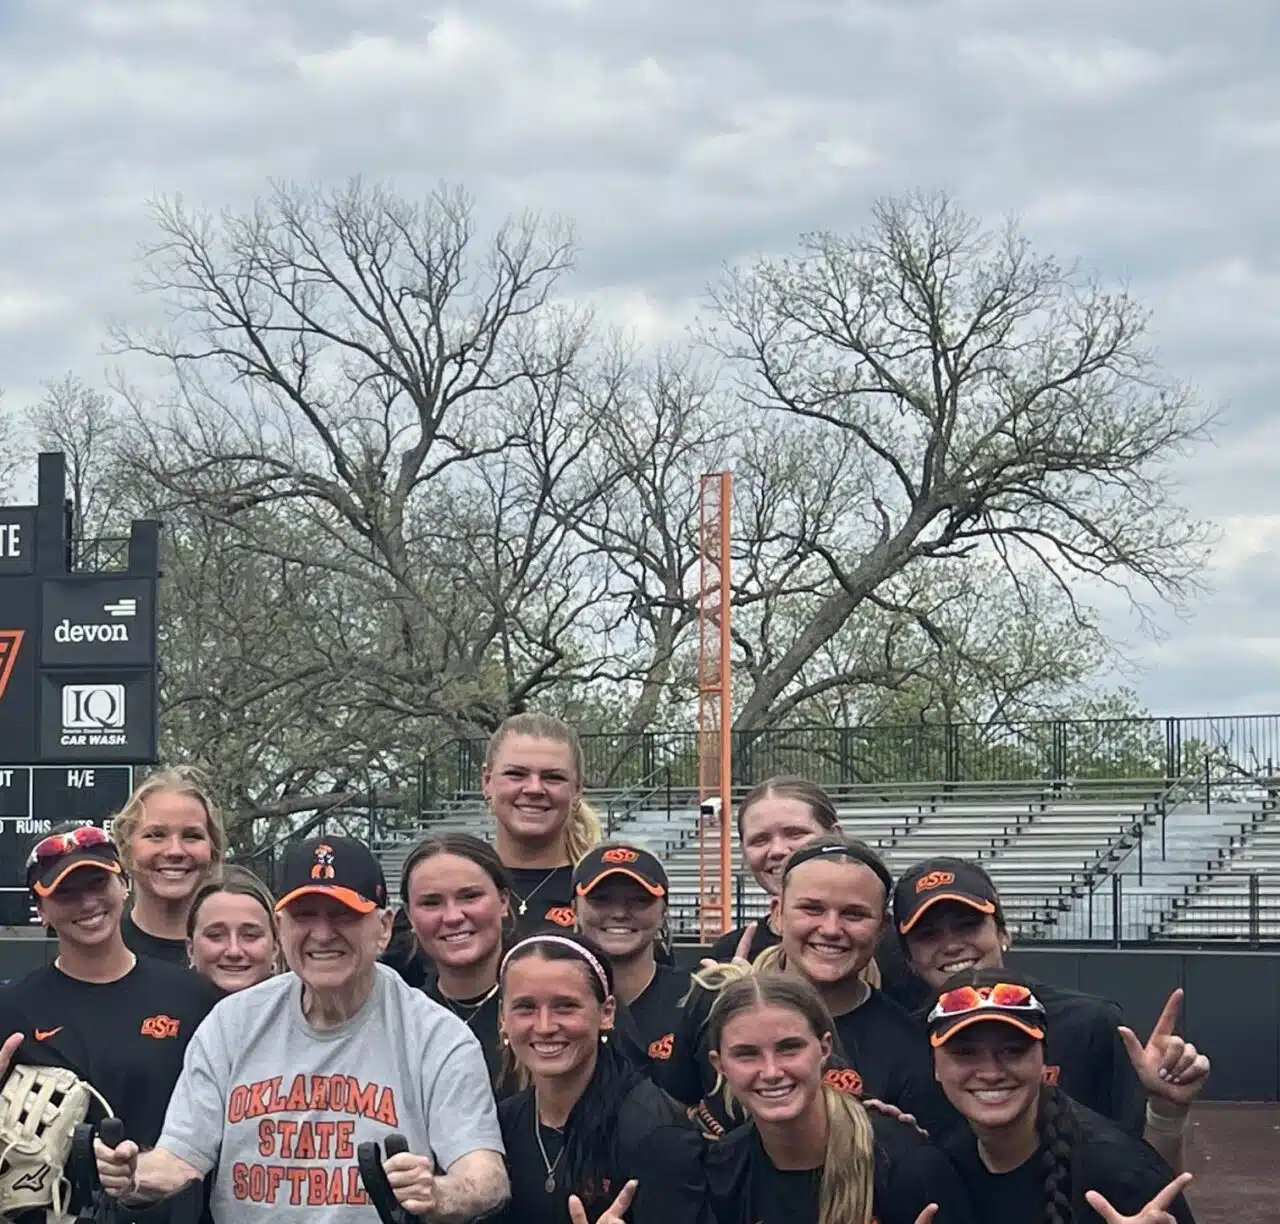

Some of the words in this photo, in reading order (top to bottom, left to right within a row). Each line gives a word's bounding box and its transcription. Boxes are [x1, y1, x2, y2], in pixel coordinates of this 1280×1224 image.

[54, 619, 129, 642] devon
[70, 688, 117, 728] IQ
[60, 734, 87, 746] CAR
[89, 734, 126, 745] WASH
[67, 769, 95, 788] H/E
[15, 819, 52, 834] RUNS
[544, 906, 577, 928] OS
[140, 1014, 182, 1040] OSU
[228, 1073, 399, 1127] OKLAHOMA
[258, 1120, 356, 1160] STATE
[232, 1162, 370, 1207] SOFTBAL
